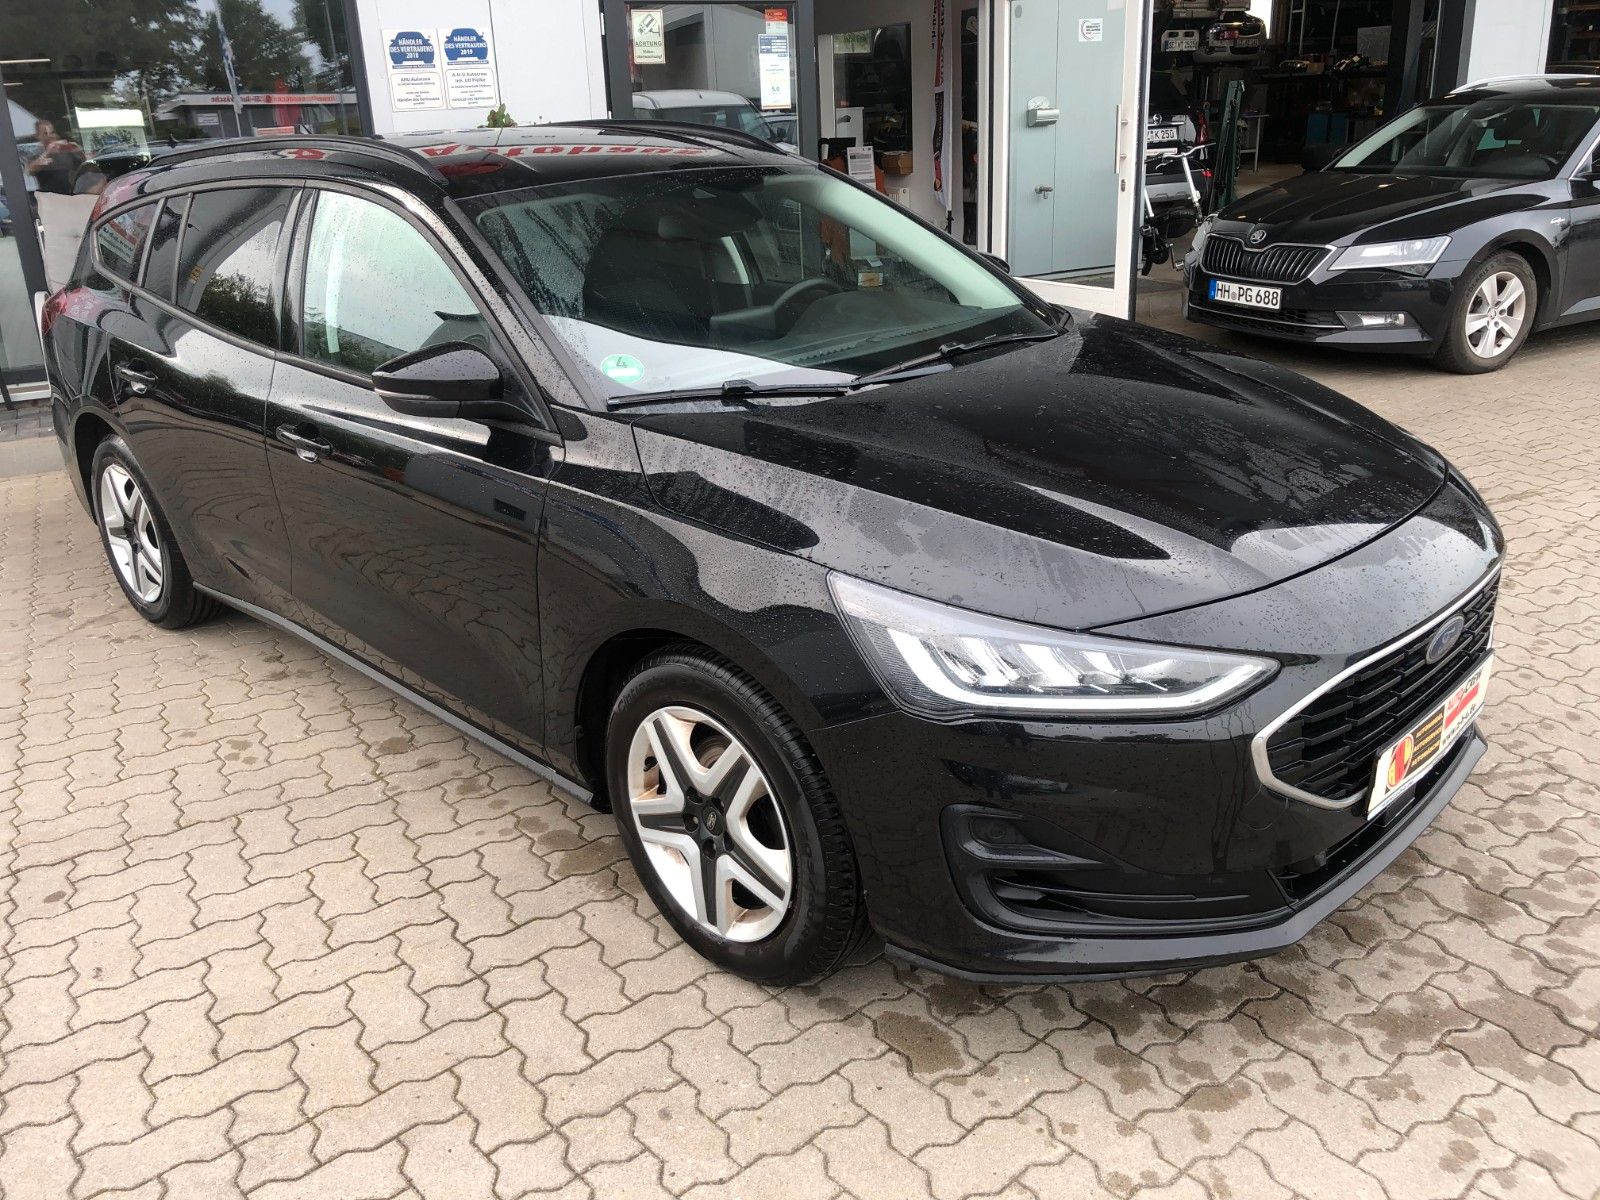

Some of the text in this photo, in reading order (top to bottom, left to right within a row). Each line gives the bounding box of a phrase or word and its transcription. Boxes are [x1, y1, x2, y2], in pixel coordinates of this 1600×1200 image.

[399, 37, 422, 46] HÄNDLER
[453, 34, 477, 42] HÄNDLER
[400, 45, 434, 53] VERTRAUENS
[455, 41, 487, 49] VERTRAUENS
[1160, 130, 1175, 140] 250
[1215, 282, 1280, 307] HH PG 688
[615, 356, 627, 368] 4
